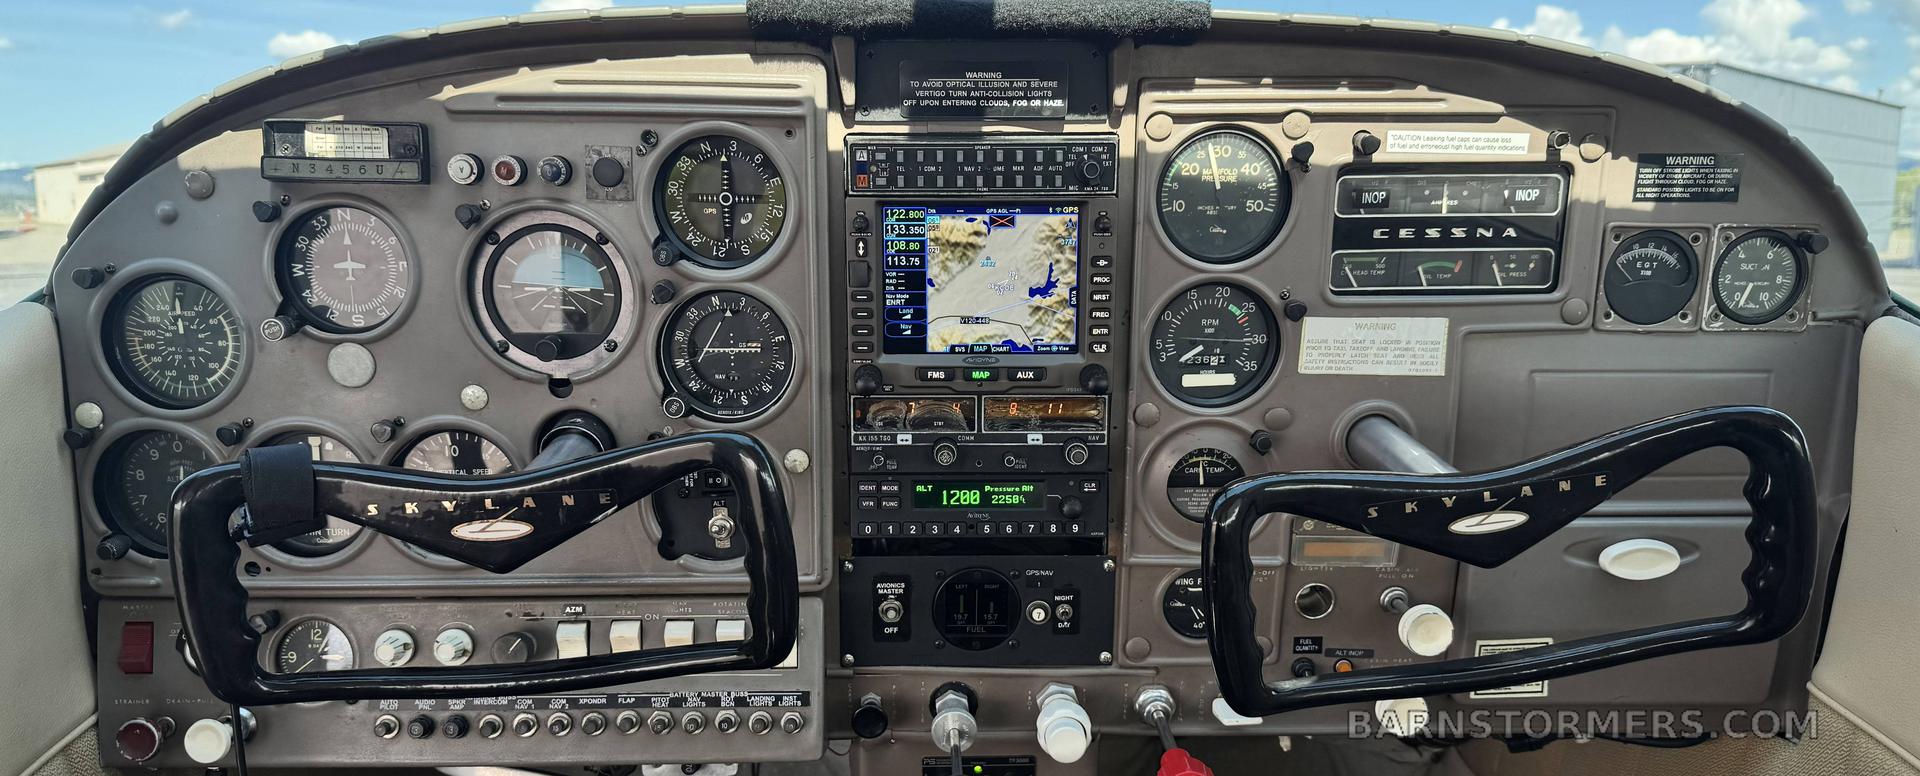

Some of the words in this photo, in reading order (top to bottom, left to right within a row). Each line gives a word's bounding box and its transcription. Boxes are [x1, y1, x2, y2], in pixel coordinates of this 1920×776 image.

[979, 100, 1010, 108] CLOUDS,
[700, 140, 712, 154] N
[729, 140, 737, 151] 3
[1665, 156, 1714, 165] WARNING
[292, 164, 384, 175] N3456U
[1181, 163, 1199, 176] 20
[1240, 163, 1261, 176] 40
[770, 176, 782, 187] E
[1362, 192, 1386, 204] INOP
[1515, 189, 1540, 201] INOP
[1172, 200, 1185, 212] 10
[1246, 200, 1264, 212] 50
[336, 208, 351, 221] N
[886, 209, 925, 219] 122.800
[312, 216, 327, 231] 33
[367, 216, 376, 227] 3
[887, 226, 925, 234] 133.350
[1373, 227, 1517, 239] CESSNA
[296, 236, 309, 252] 30
[1767, 250, 1774, 259] 6
[887, 257, 920, 265] 113.75
[291, 263, 305, 277] W
[1725, 274, 1731, 283] 2
[1776, 275, 1782, 284] 8
[1187, 289, 1198, 300] 15
[1215, 287, 1231, 297] 20
[1760, 292, 1769, 301] 10
[1242, 302, 1256, 313] 25
[352, 315, 365, 326] S
[1251, 334, 1266, 344] 30
[1242, 361, 1258, 371] 35
[149, 449, 159, 461] 9
[446, 445, 459, 457] 10
[136, 469, 145, 480] 8
[139, 494, 147, 505] 7
[942, 490, 980, 505] 1200
[1367, 475, 1607, 518] SKYLANE
[367, 493, 611, 516] SKYLANE
[865, 526, 872, 534] 0
[888, 526, 892, 534] 1
[910, 526, 916, 534] 2
[932, 526, 938, 534] 3
[954, 526, 960, 534] 4
[984, 525, 990, 533] 5
[1006, 525, 1012, 533] 6
[1028, 525, 1034, 533] 7
[1050, 524, 1056, 532] 8
[1072, 524, 1079, 532] 9
[311, 629, 322, 641] 12
[287, 651, 297, 662] 9
